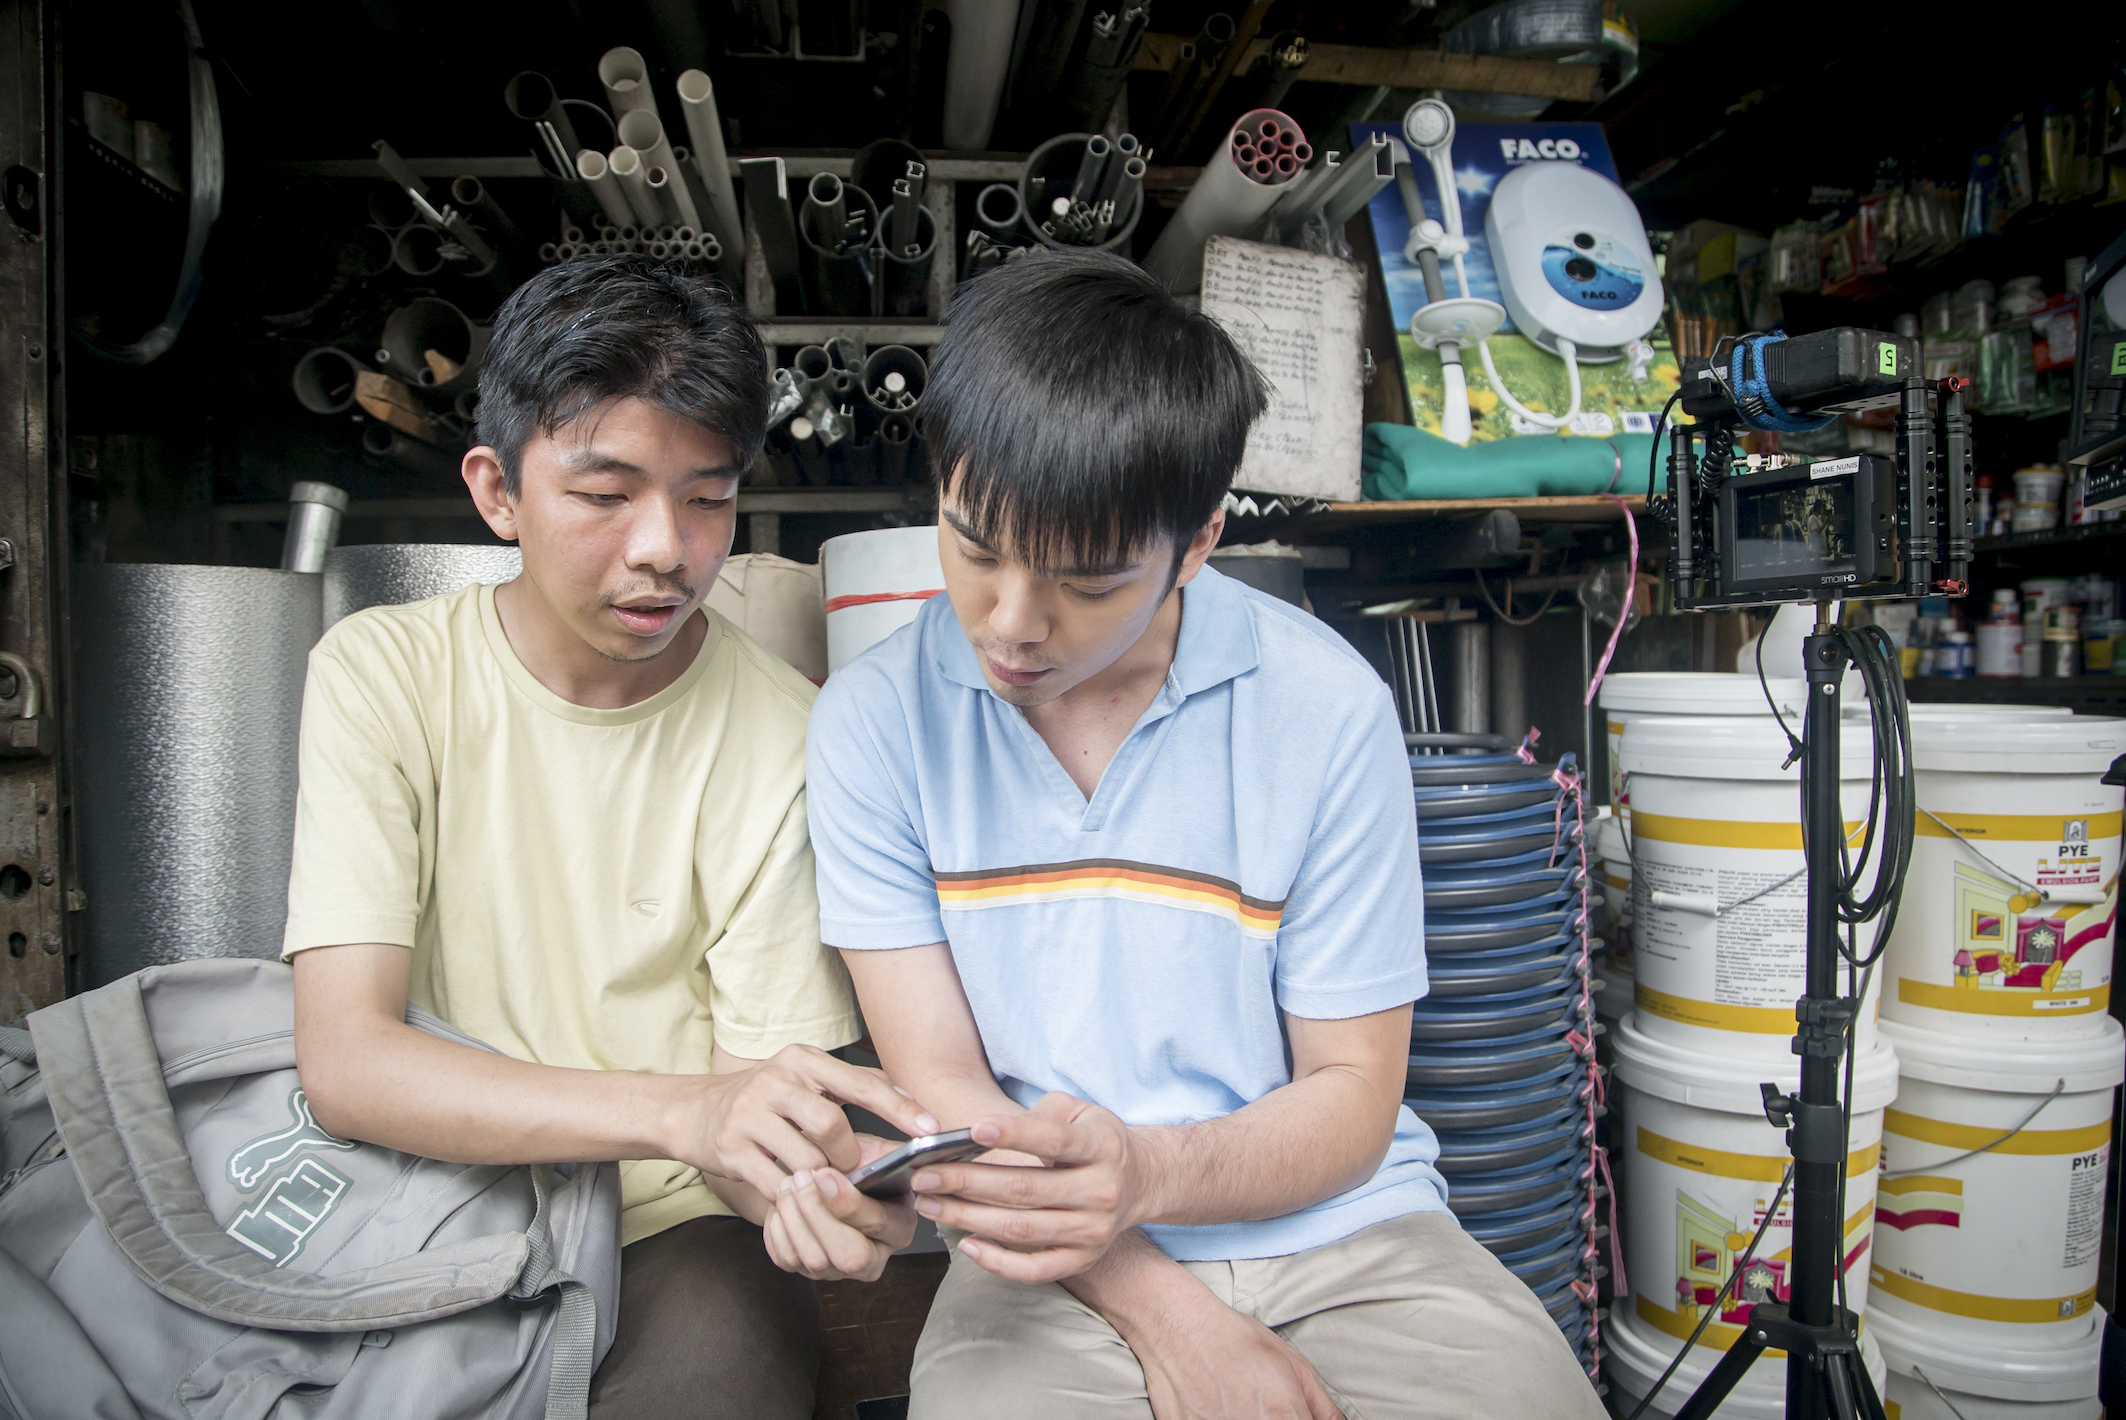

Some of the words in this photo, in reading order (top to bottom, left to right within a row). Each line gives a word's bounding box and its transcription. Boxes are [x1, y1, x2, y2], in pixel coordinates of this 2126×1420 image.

[1501, 138, 1580, 160] FACO
[1582, 290, 1618, 300] FACO
[1812, 466, 1835, 475] SHANE
[1836, 461, 1858, 471] NUNIS
[1821, 573, 1857, 585] smallHD
[2058, 844, 2089, 857] PYE
[2037, 857, 2101, 875] LITE
[1677, 1155, 1705, 1167] INTERIOR
[2072, 1152, 2098, 1171] PYE
